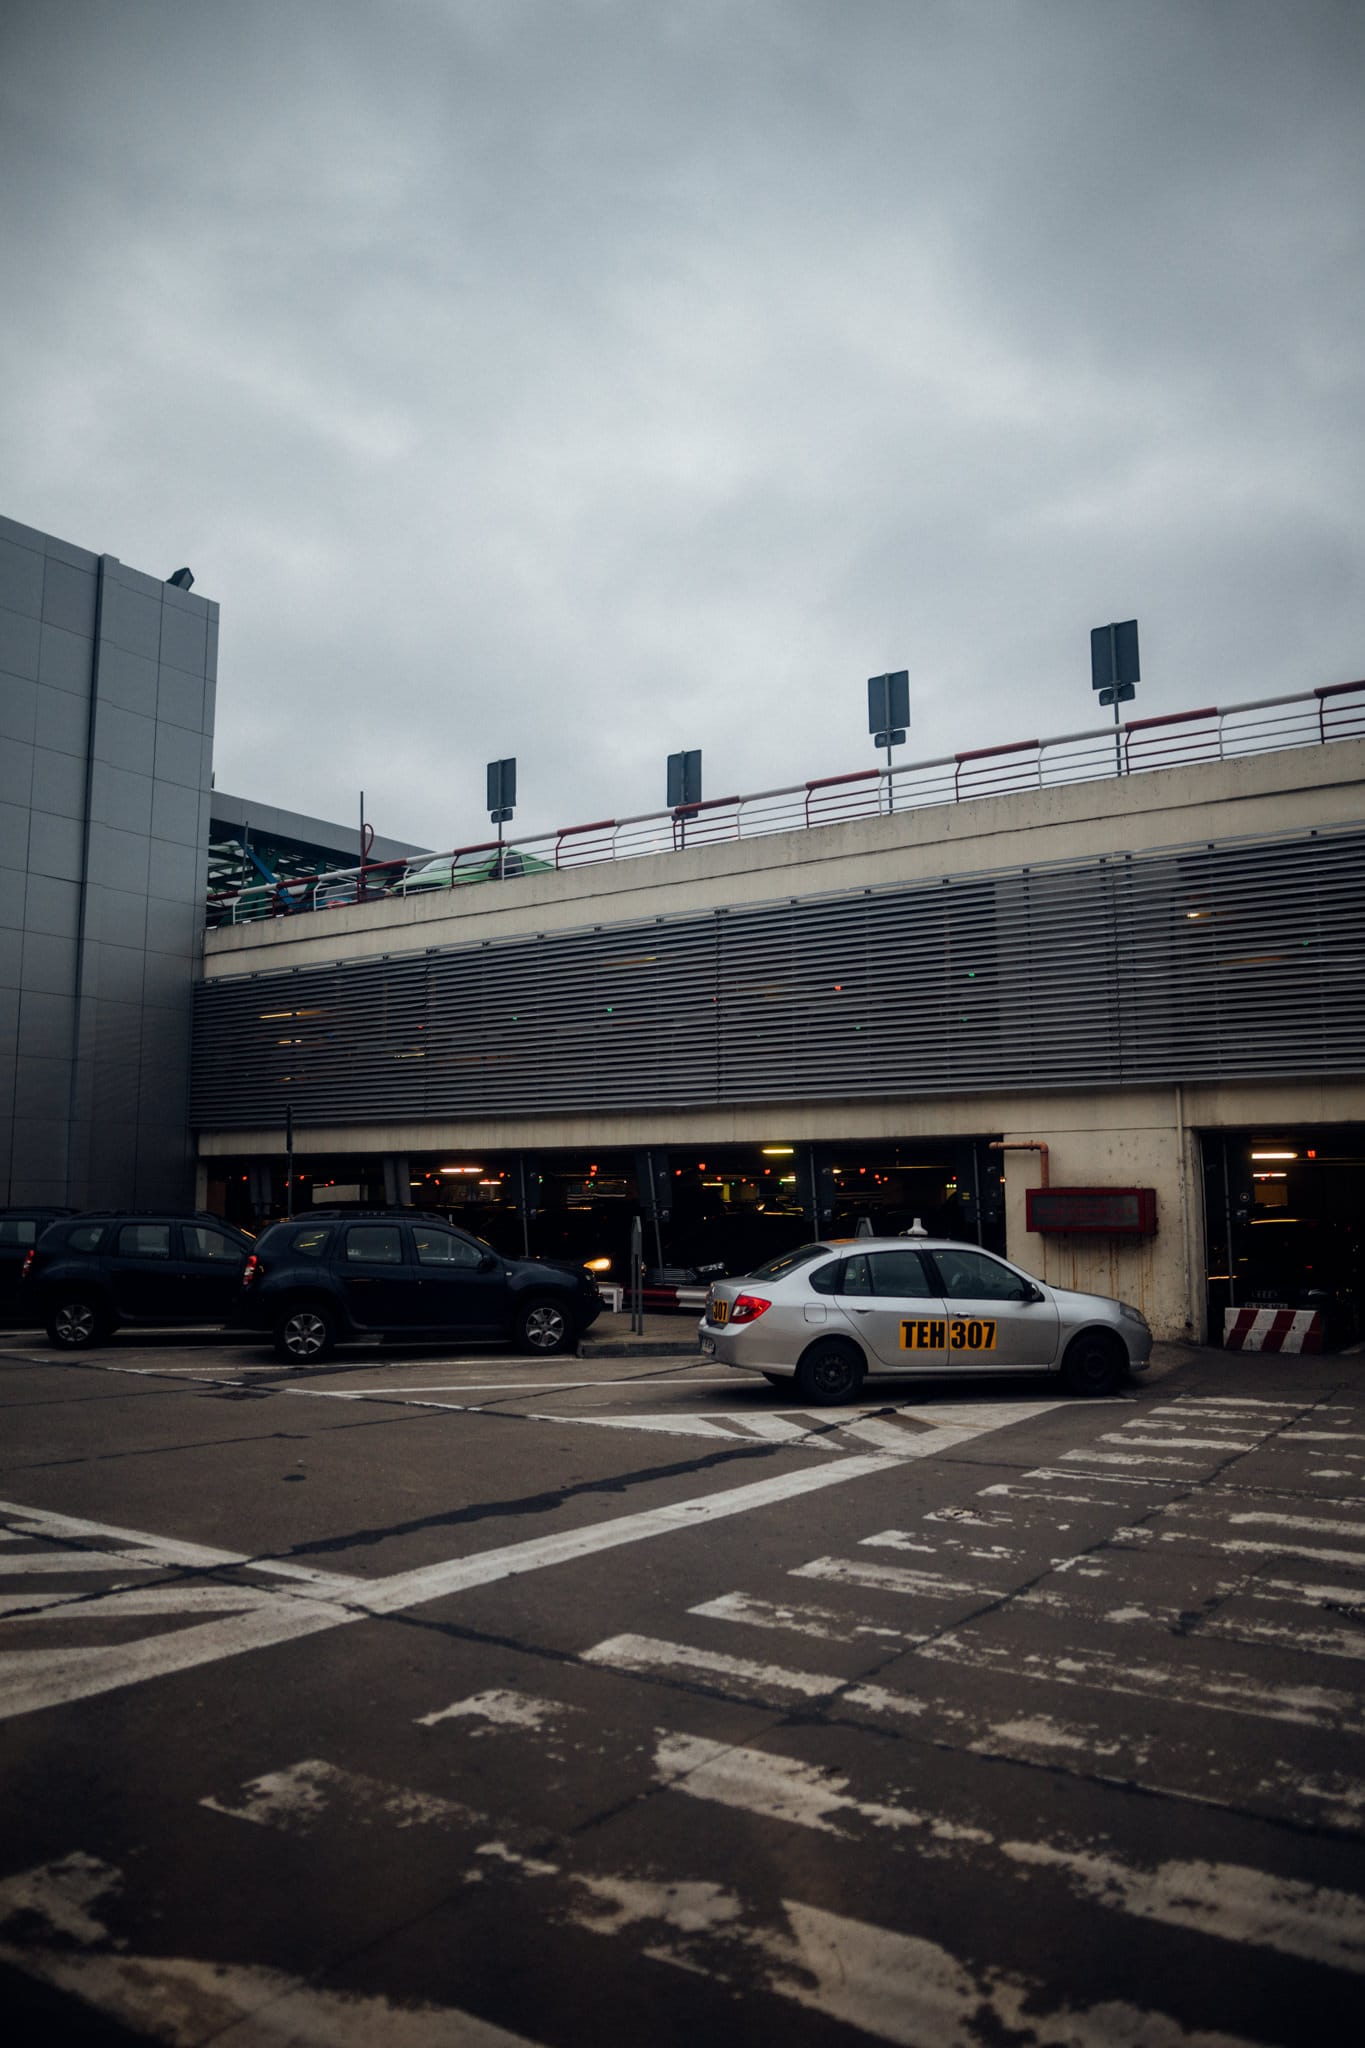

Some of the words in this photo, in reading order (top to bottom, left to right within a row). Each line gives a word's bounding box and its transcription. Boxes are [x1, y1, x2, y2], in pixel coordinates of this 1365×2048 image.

[713, 1301, 727, 1321] 307
[902, 1321, 945, 1348] TEH
[951, 1321, 995, 1349] 307
